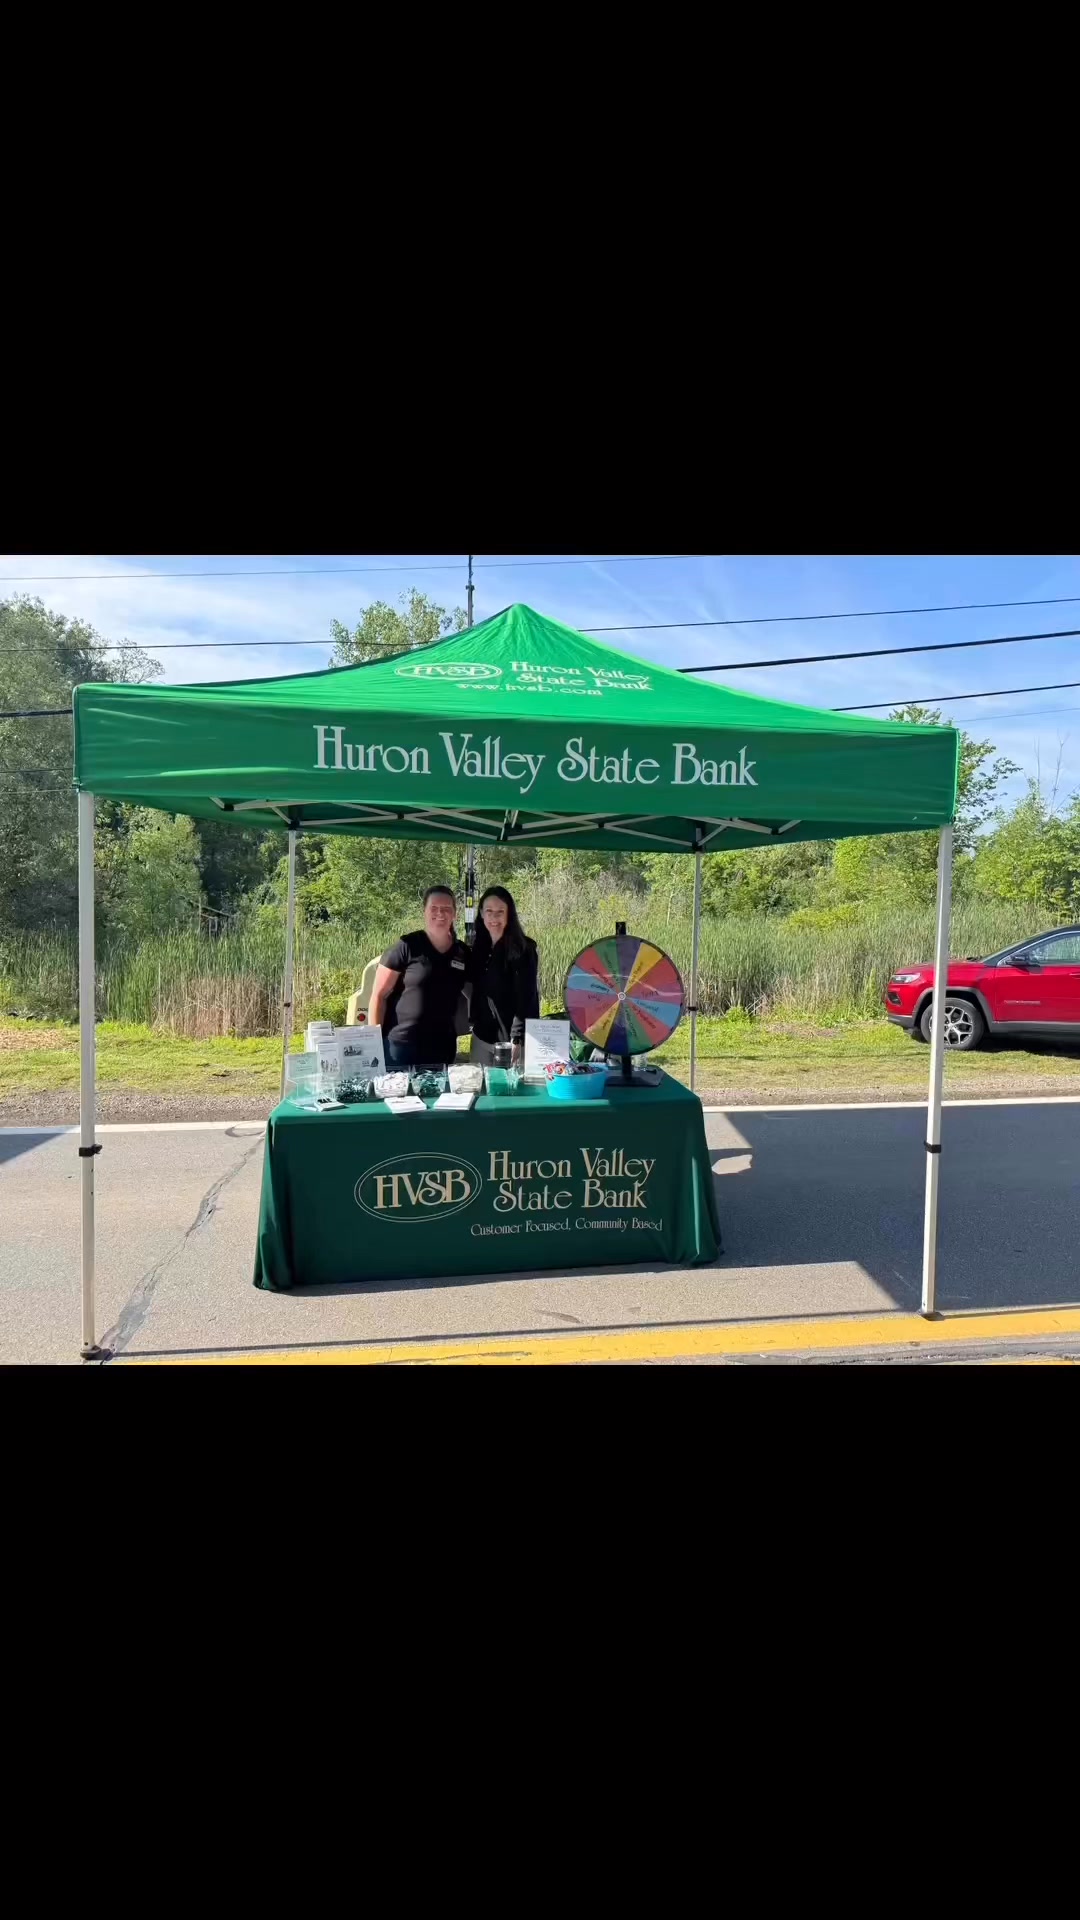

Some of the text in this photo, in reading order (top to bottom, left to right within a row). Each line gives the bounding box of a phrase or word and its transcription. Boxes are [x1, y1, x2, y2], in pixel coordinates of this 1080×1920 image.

[413, 666, 491, 676] HVSB
[510, 661, 650, 682] Huron Valley
[516, 672, 654, 691] State Bank
[455, 683, 604, 696] www.hvsb.com
[313, 725, 759, 794] Huron Valley State Bank
[487, 1147, 656, 1187] Huron Valley
[373, 1169, 471, 1209] HVSB
[493, 1179, 647, 1212] State Bank
[470, 1217, 663, 1236] Customer Focused, Community Based
